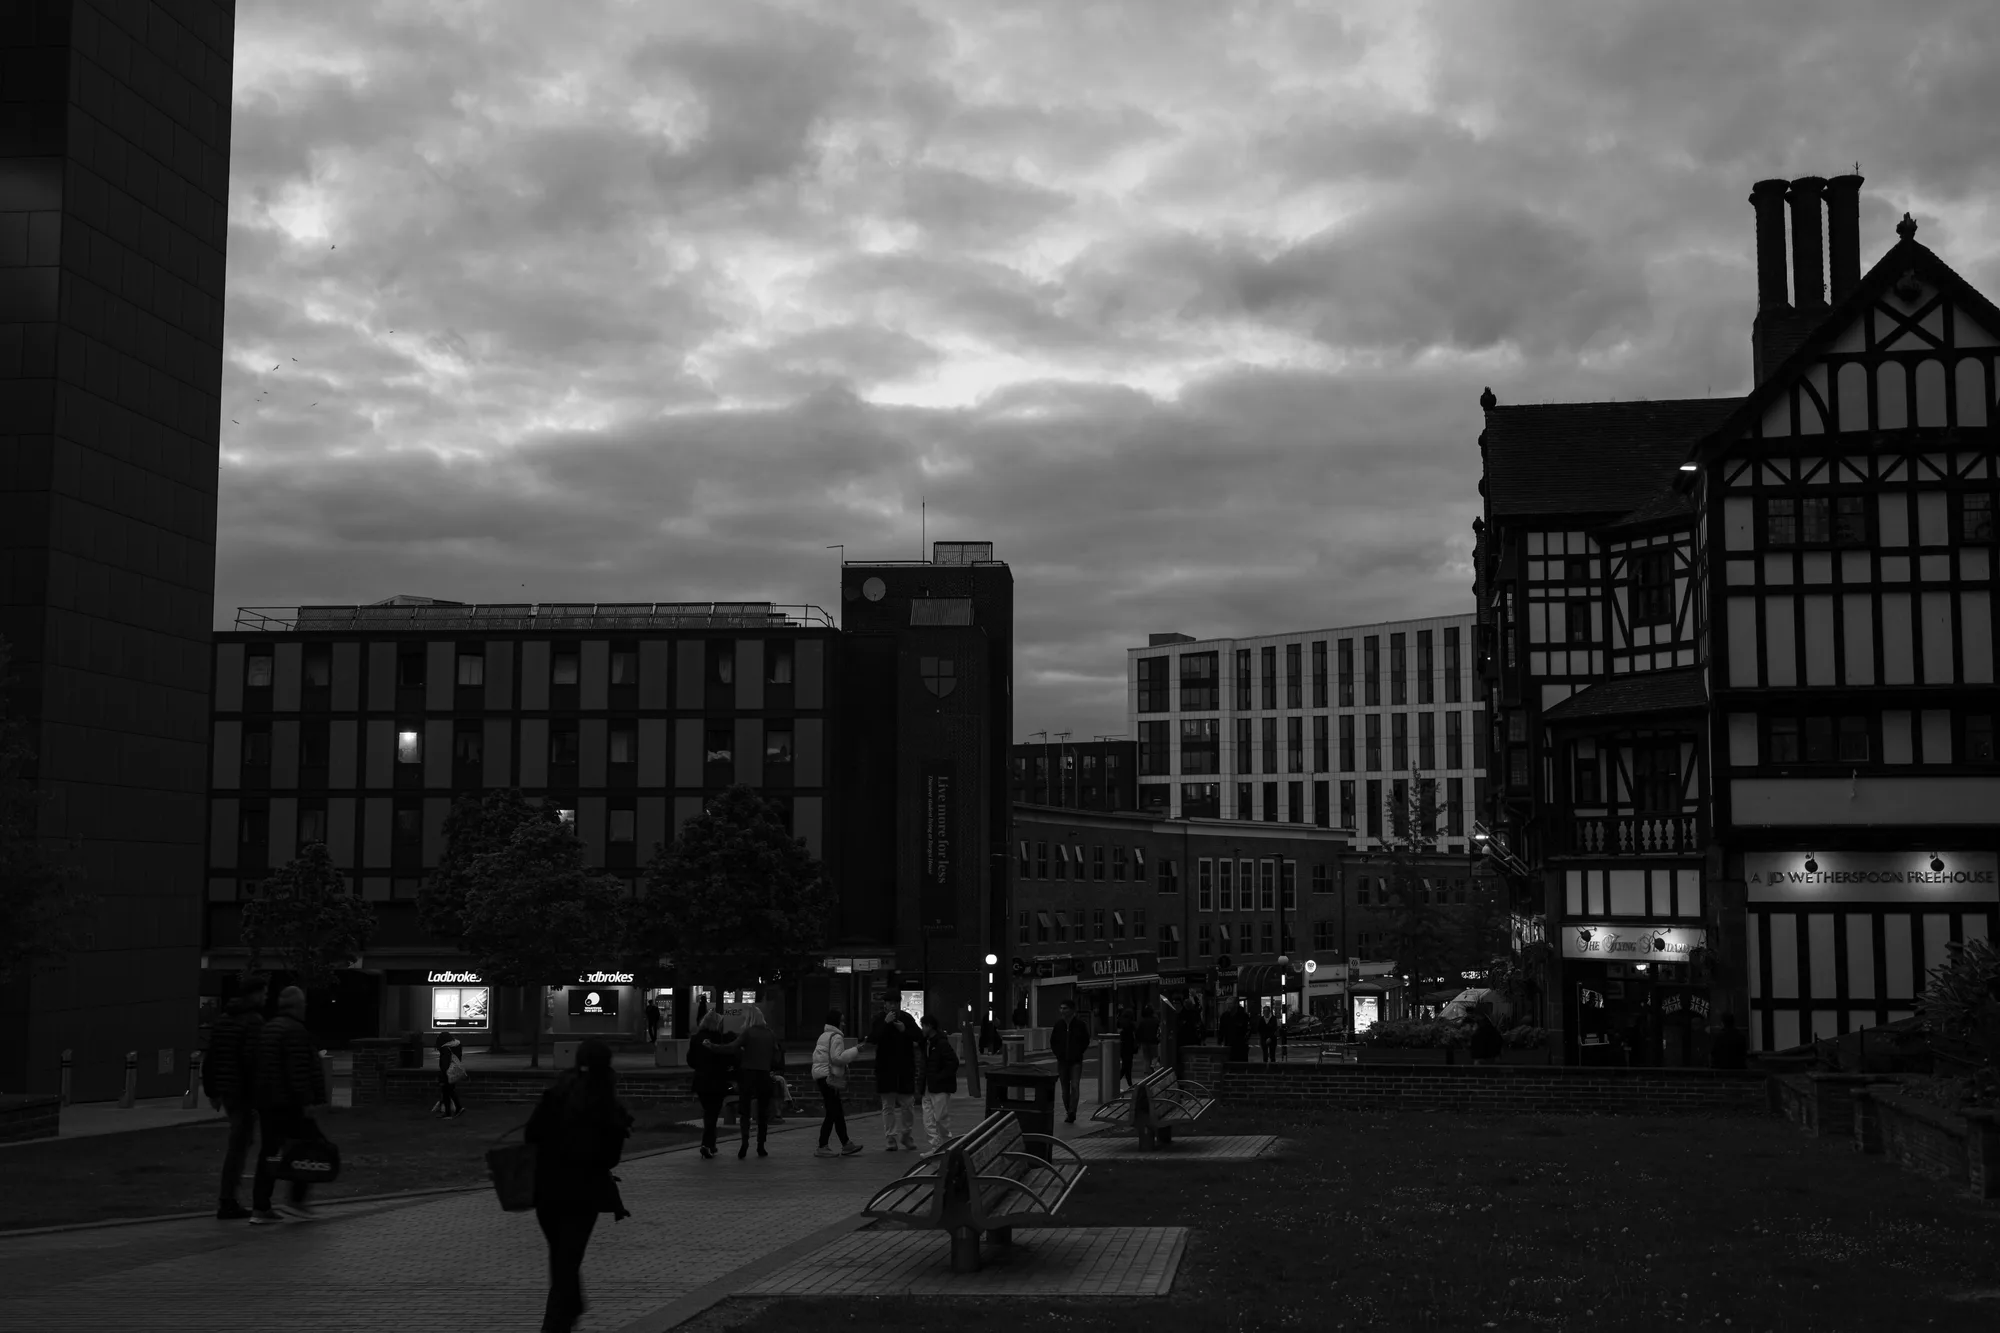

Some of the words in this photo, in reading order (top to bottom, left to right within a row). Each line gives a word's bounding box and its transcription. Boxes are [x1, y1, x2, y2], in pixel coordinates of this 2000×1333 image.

[938, 775, 949, 802] Live
[937, 804, 946, 837] more
[937, 840, 949, 858] for
[937, 860, 949, 884] less
[1750, 873, 1762, 883] A
[1766, 872, 1785, 886] JD
[1788, 871, 1904, 884] WETHERSPOON
[1907, 871, 1996, 884] FREEHOUSE
[1092, 956, 1113, 976] CAFÉ
[1114, 958, 1139, 974] ITALIA
[292, 1159, 331, 1171] adidas
